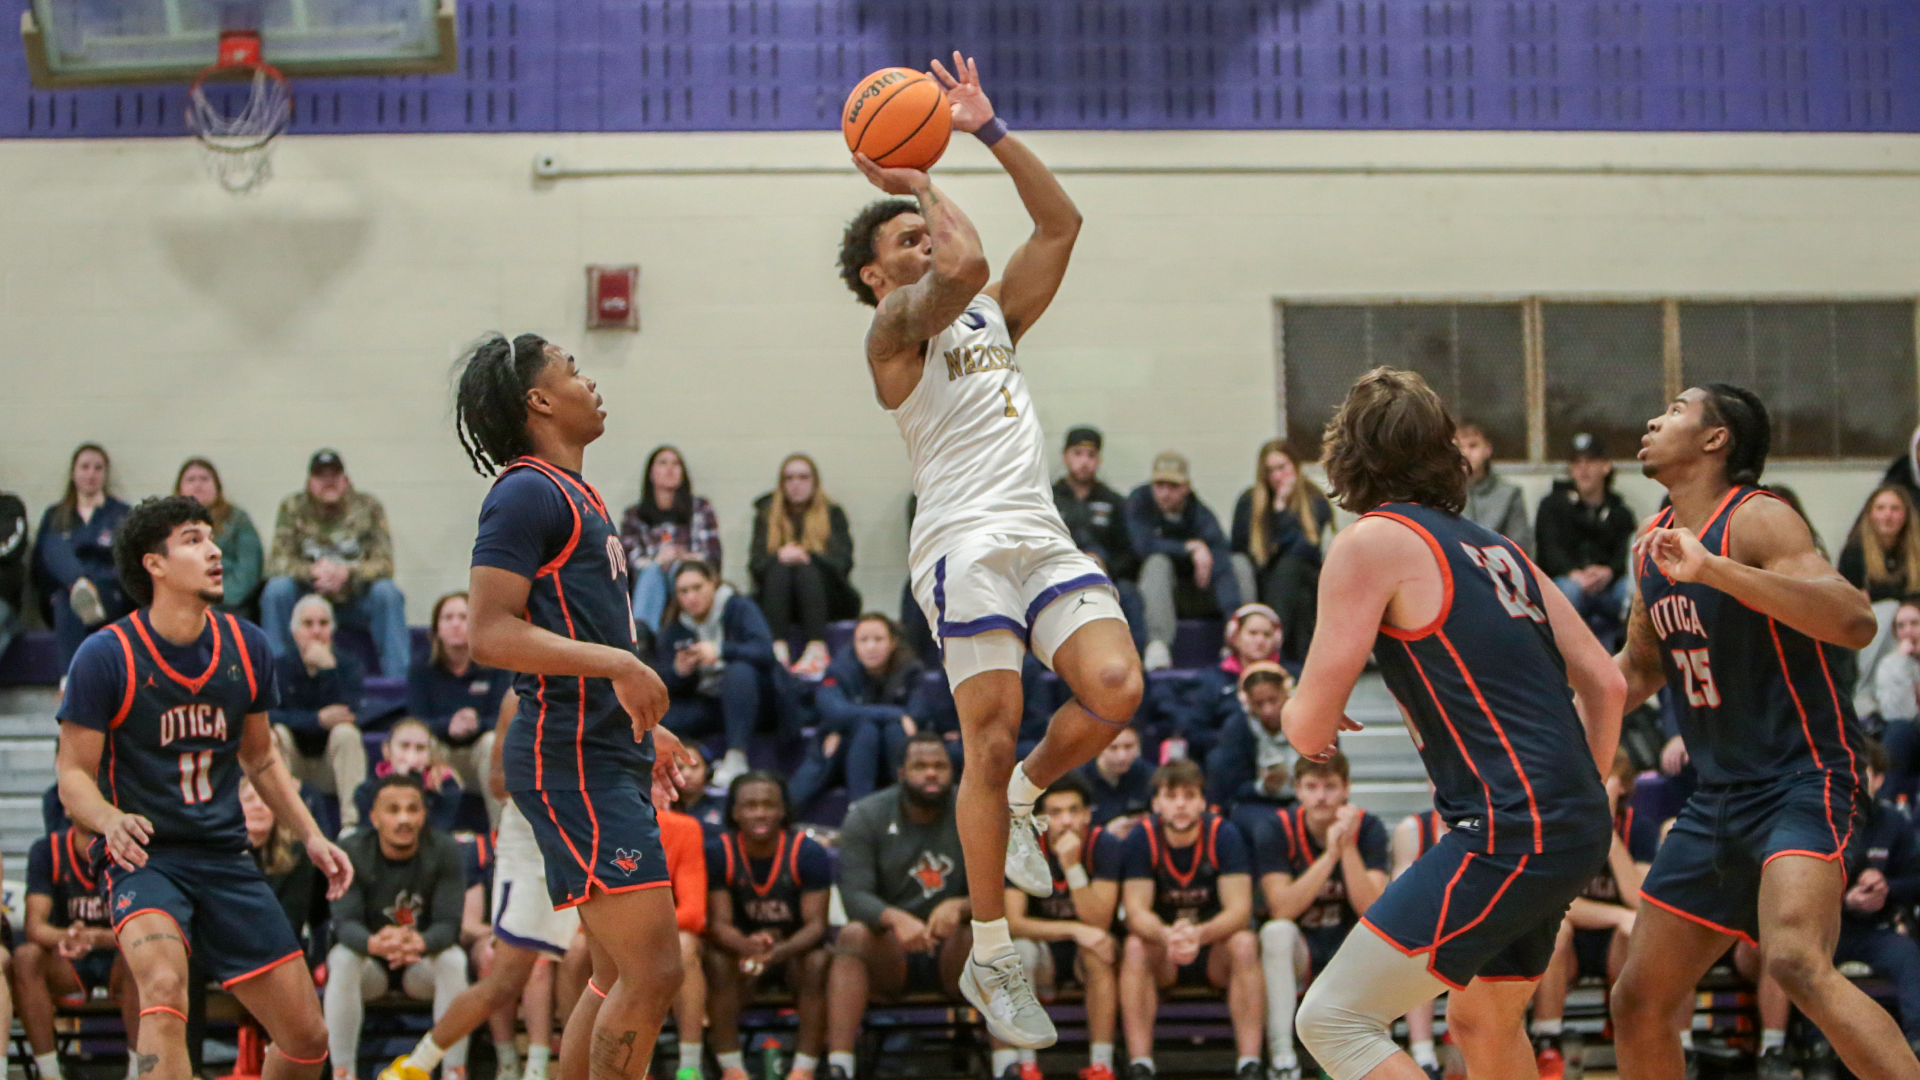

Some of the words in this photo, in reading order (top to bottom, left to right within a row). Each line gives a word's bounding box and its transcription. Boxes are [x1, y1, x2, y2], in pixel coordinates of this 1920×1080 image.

[849, 71, 908, 123] Wilson
[999, 385, 1019, 417] 1
[1650, 594, 1708, 640] UTICA
[1671, 648, 1722, 708] 25
[160, 703, 227, 747] UTICA
[178, 749, 213, 805] 11
